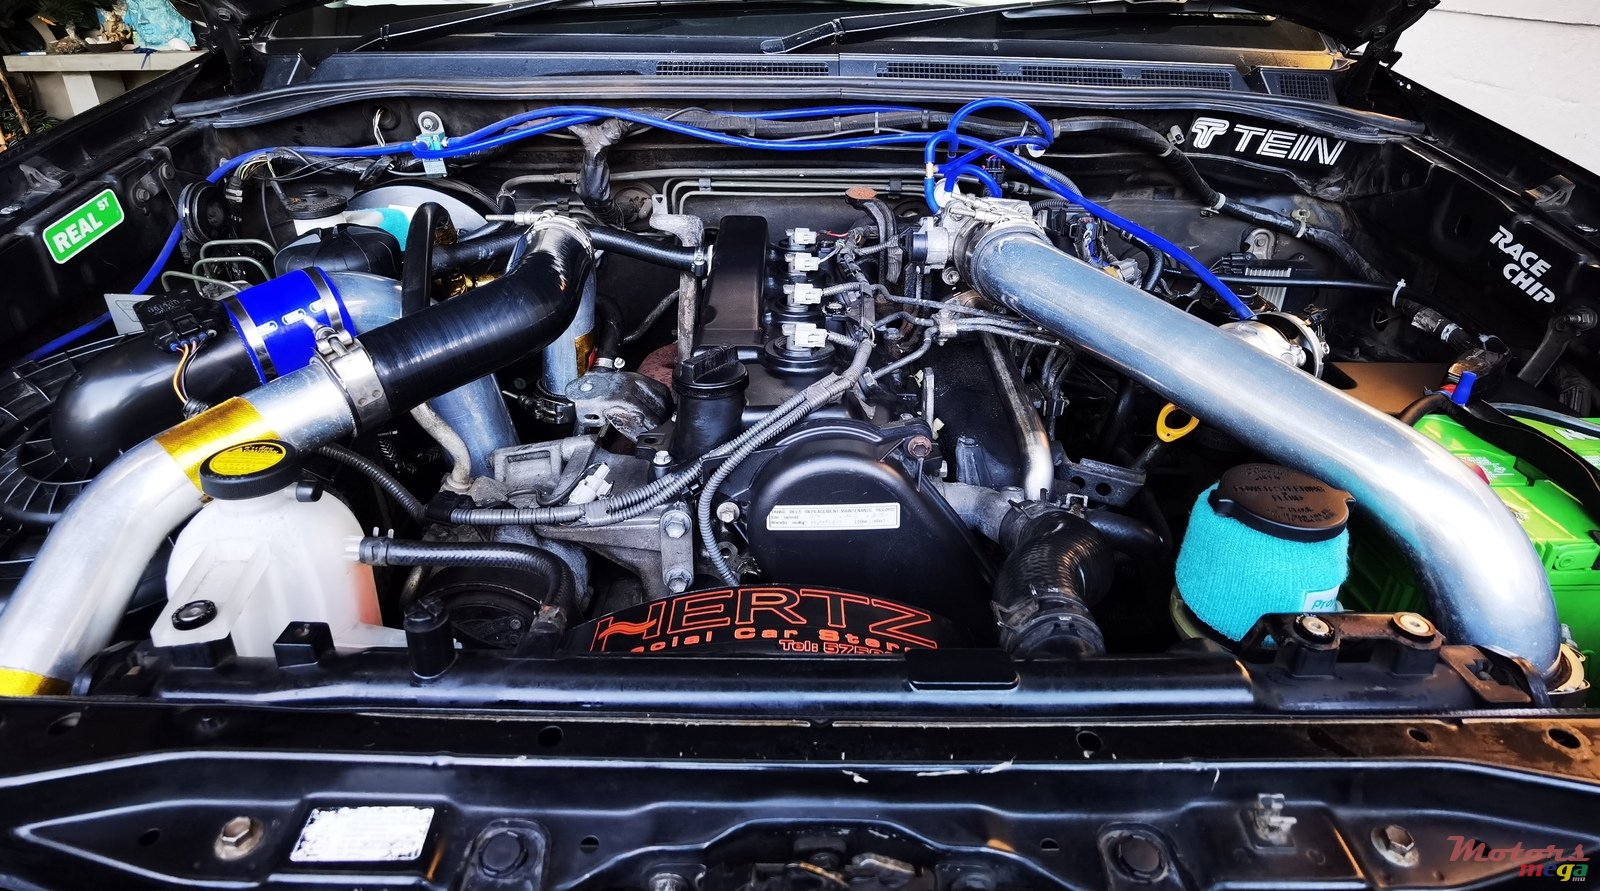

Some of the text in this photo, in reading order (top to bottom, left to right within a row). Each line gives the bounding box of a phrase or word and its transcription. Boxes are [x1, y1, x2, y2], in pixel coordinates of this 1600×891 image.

[1234, 124, 1347, 166] TEIN
[52, 196, 110, 254] REAL ST
[1489, 224, 1552, 278] RACE
[1502, 262, 1556, 304] CHIP
[589, 587, 938, 652] HERTZ
[733, 627, 798, 640] Car
